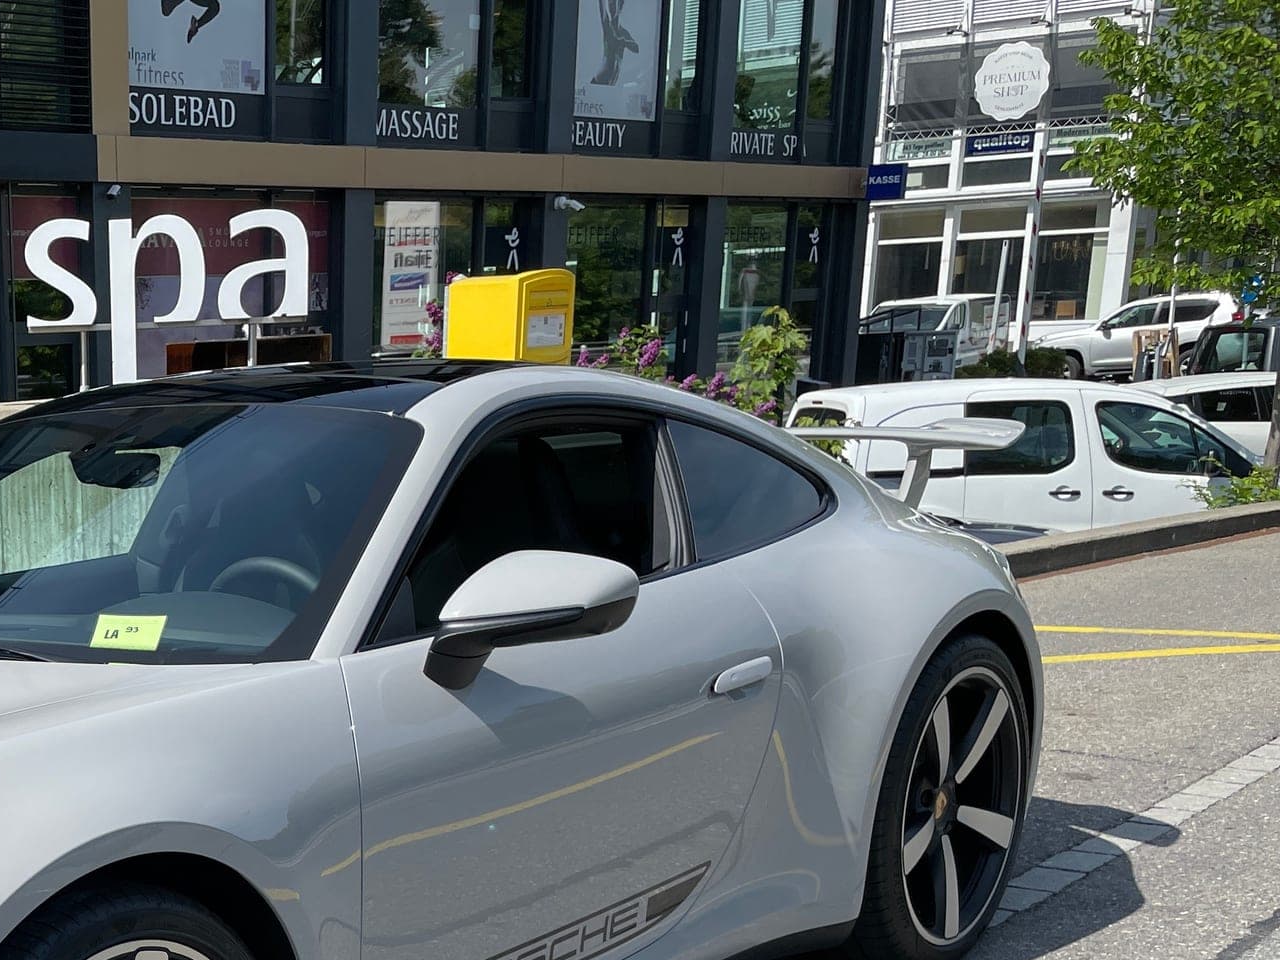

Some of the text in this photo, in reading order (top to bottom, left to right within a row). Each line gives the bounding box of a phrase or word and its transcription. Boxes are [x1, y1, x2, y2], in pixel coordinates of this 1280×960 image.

[136, 63, 185, 86] fitness
[983, 70, 1041, 85] PREMIUM
[128, 92, 236, 128] SOLEBAD
[375, 109, 459, 140] MASSAGE
[730, 131, 775, 156] RIVATE
[973, 134, 1030, 150] qualitop
[869, 175, 901, 184] KASSE
[208, 239, 249, 248] LOUNGE
[24, 208, 309, 385] spa
[103, 629, 119, 639] LA
